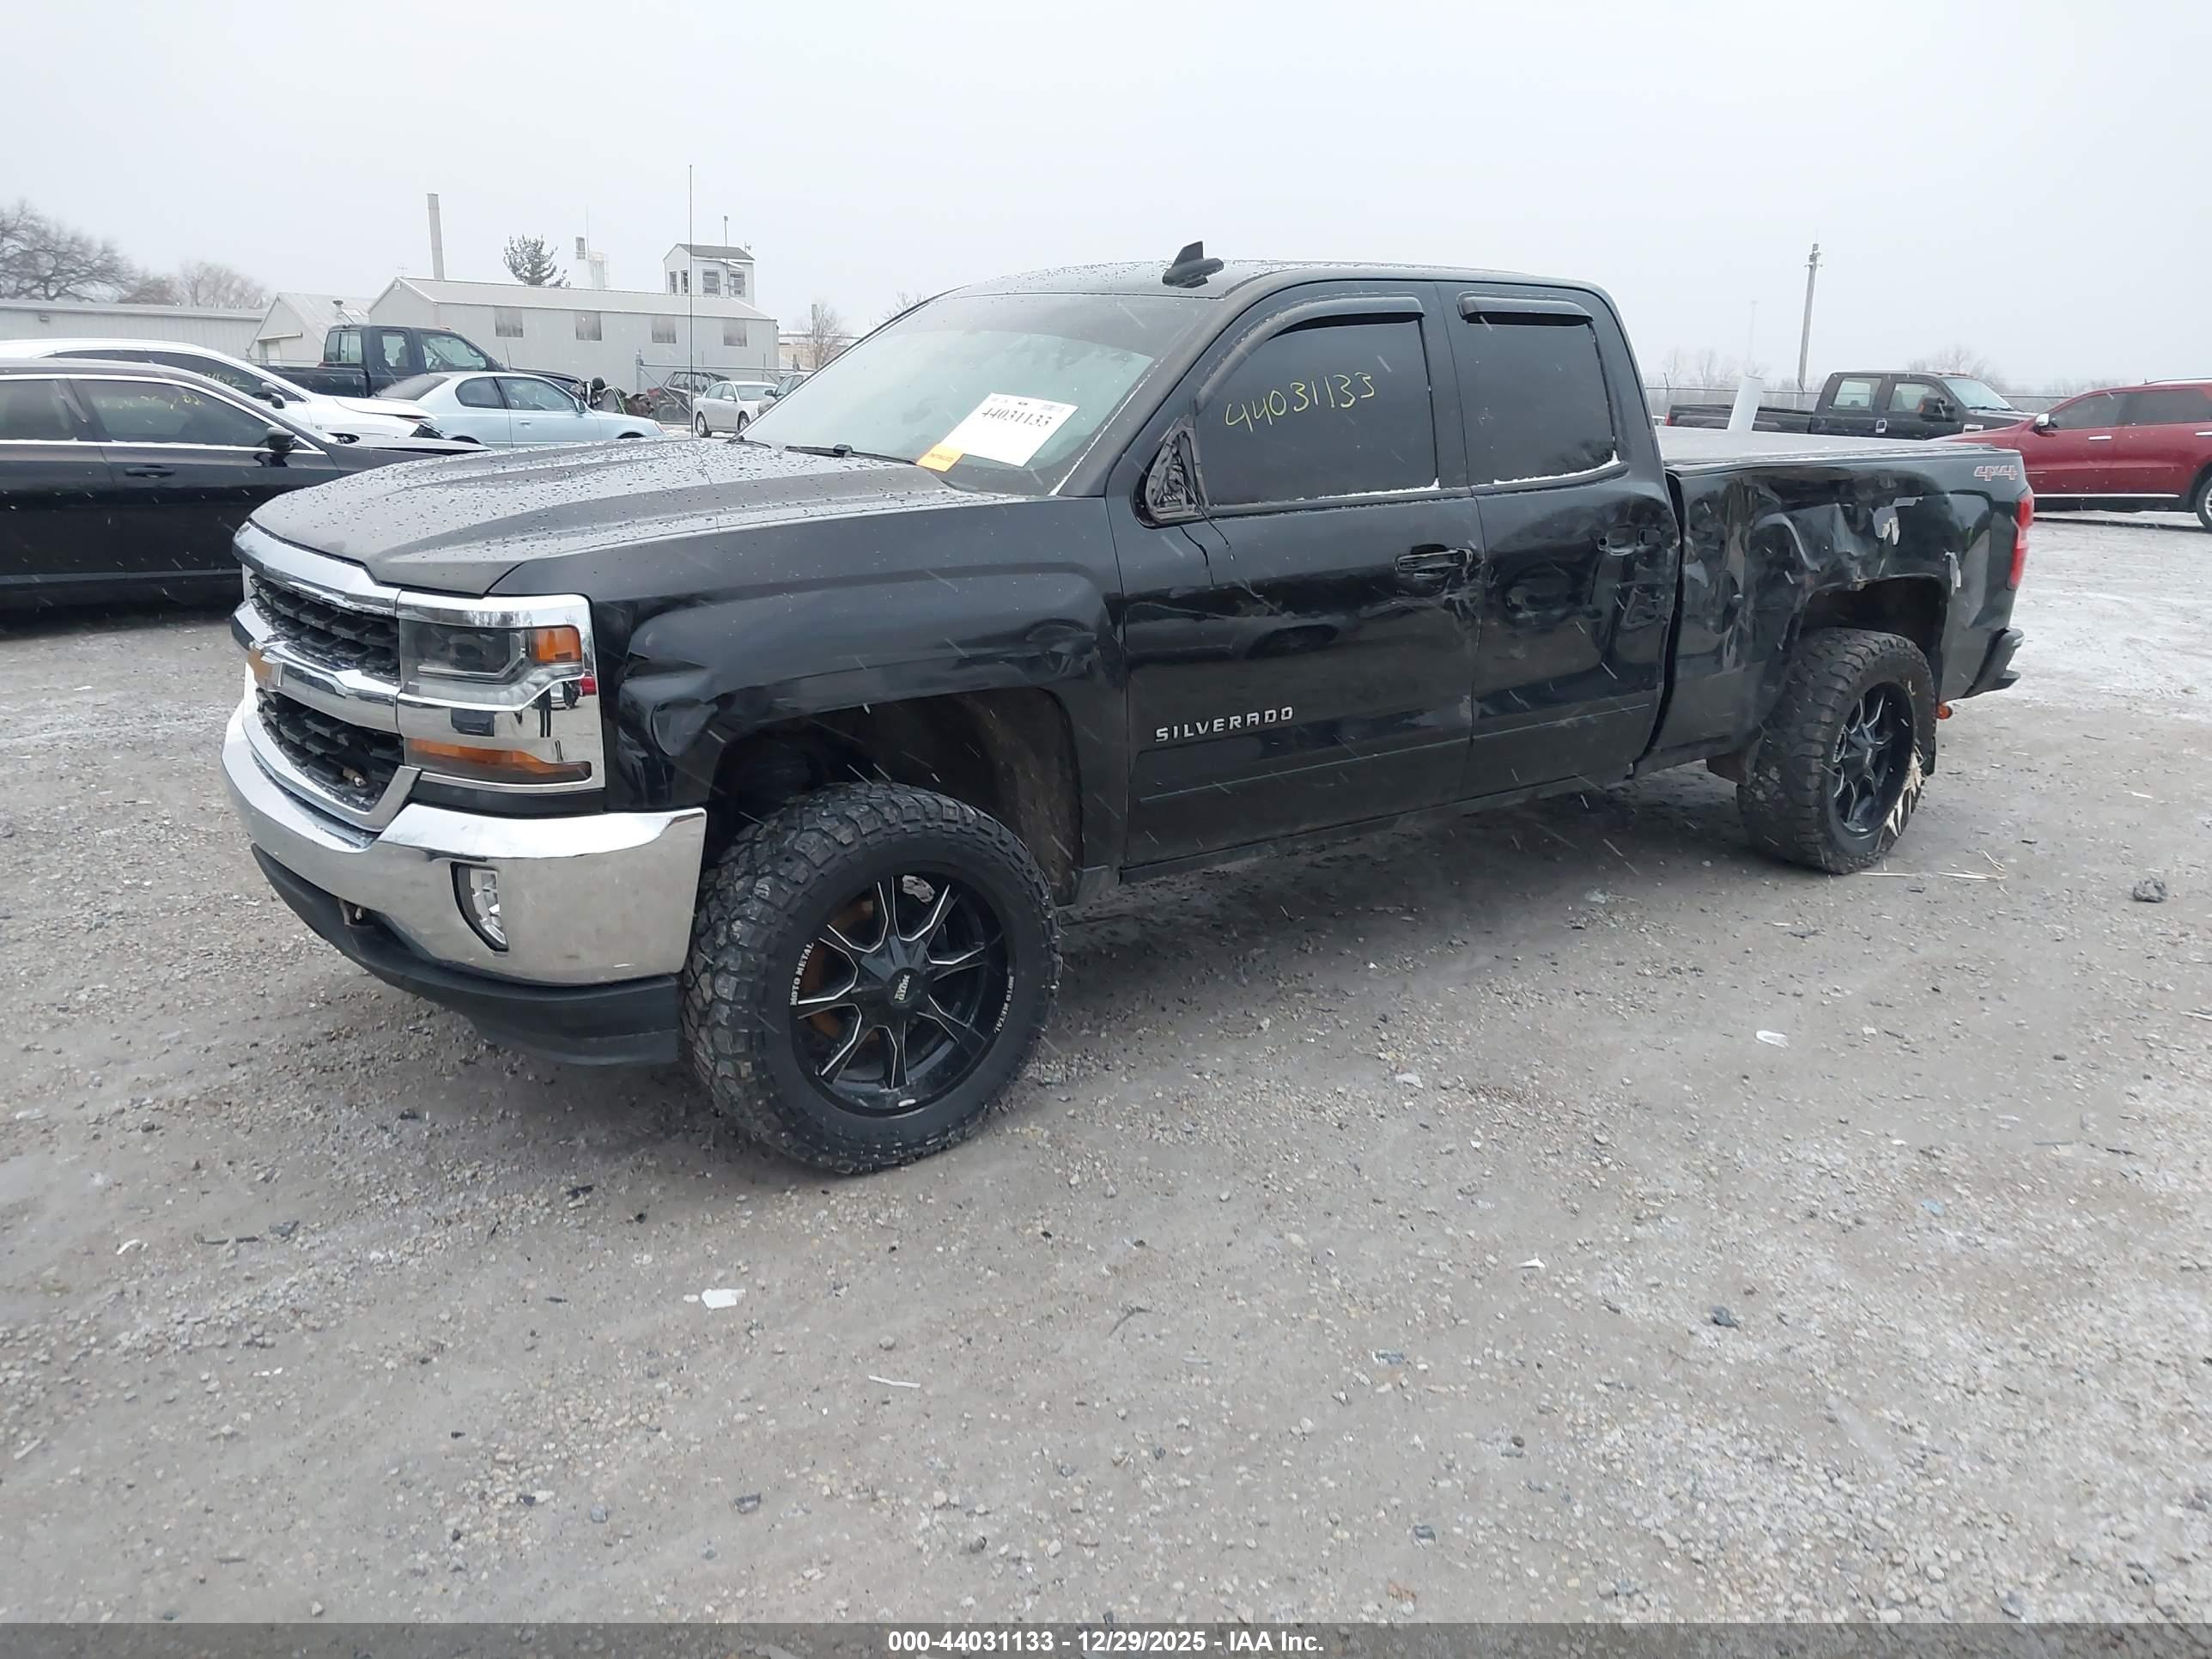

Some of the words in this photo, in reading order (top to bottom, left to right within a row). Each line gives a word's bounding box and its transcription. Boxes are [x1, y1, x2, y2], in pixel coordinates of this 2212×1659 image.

[981, 407, 1053, 428] 44031133
[1224, 371, 1375, 433] 44031133
[1155, 706, 1293, 742] SILVERADO
[795, 942, 814, 976] METAL
[790, 977, 801, 1006] MOTO
